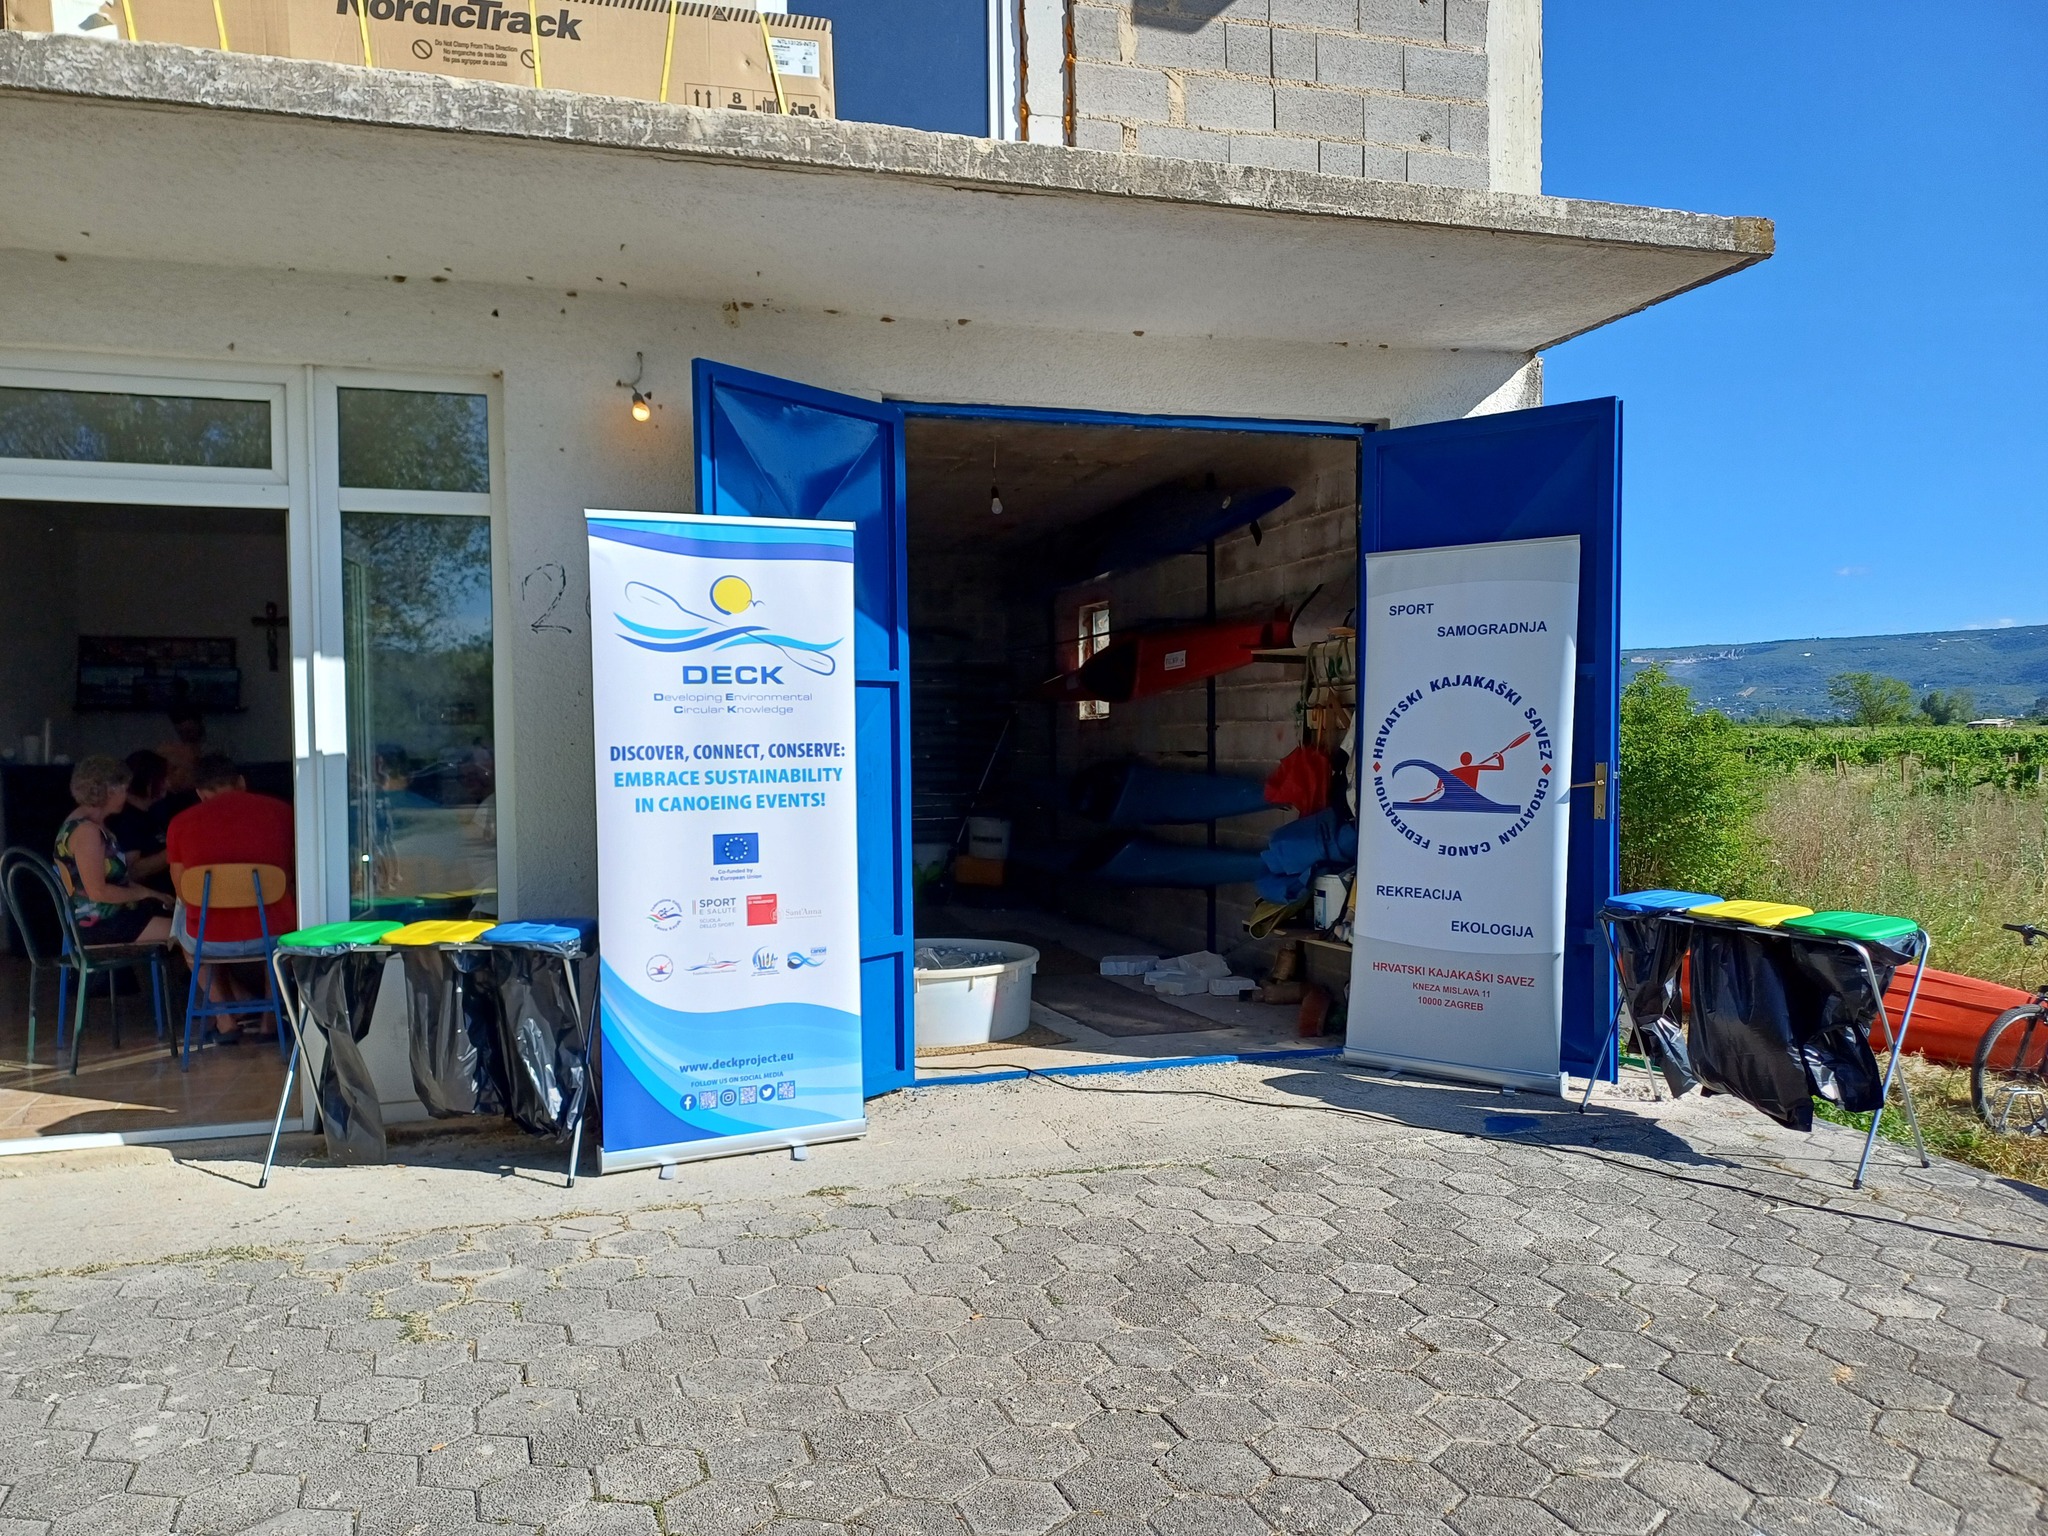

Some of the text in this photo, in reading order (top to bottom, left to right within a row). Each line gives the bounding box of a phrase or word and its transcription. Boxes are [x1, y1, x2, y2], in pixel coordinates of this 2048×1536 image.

[732, 92, 742, 104] 8
[521, 563, 572, 634] 2
[1389, 603, 1434, 616] SPORT
[1437, 621, 1547, 637] SAMOGRADNJA
[682, 665, 785, 685] DECK
[653, 692, 813, 704] Developing Environmental
[673, 705, 794, 715] Circular Knowledge
[1373, 674, 1552, 761] HRVATSKI KAJAKAŠKI SAVEZ
[609, 742, 846, 762] DISCOVER, CONNECT, CONSERVE:
[613, 767, 843, 788] EMBRACE SUSTAINABILITY
[635, 792, 826, 813] IN CANOEING EVENTS!
[1374, 776, 1549, 857] CROATIAN CANOE FEDERATION
[1376, 885, 1462, 901] REKREACIJA
[699, 897, 736, 908] SPORT
[707, 907, 736, 915] SALUTE
[1451, 920, 1534, 938] EKOLOGIJA
[1372, 961, 1535, 988] HRVATSKI KAJAKAŠKI SAVEZ
[1412, 982, 1491, 998] KNEZA MISLAVA 11
[1418, 996, 1484, 1011] 10000 ZAGREB
[679, 1053, 794, 1073] www.deckproject.eu
[690, 1080, 718, 1088] FOLLOW
[740, 1074, 762, 1082] SOCIAL
[763, 1071, 784, 1079] MEDIA
